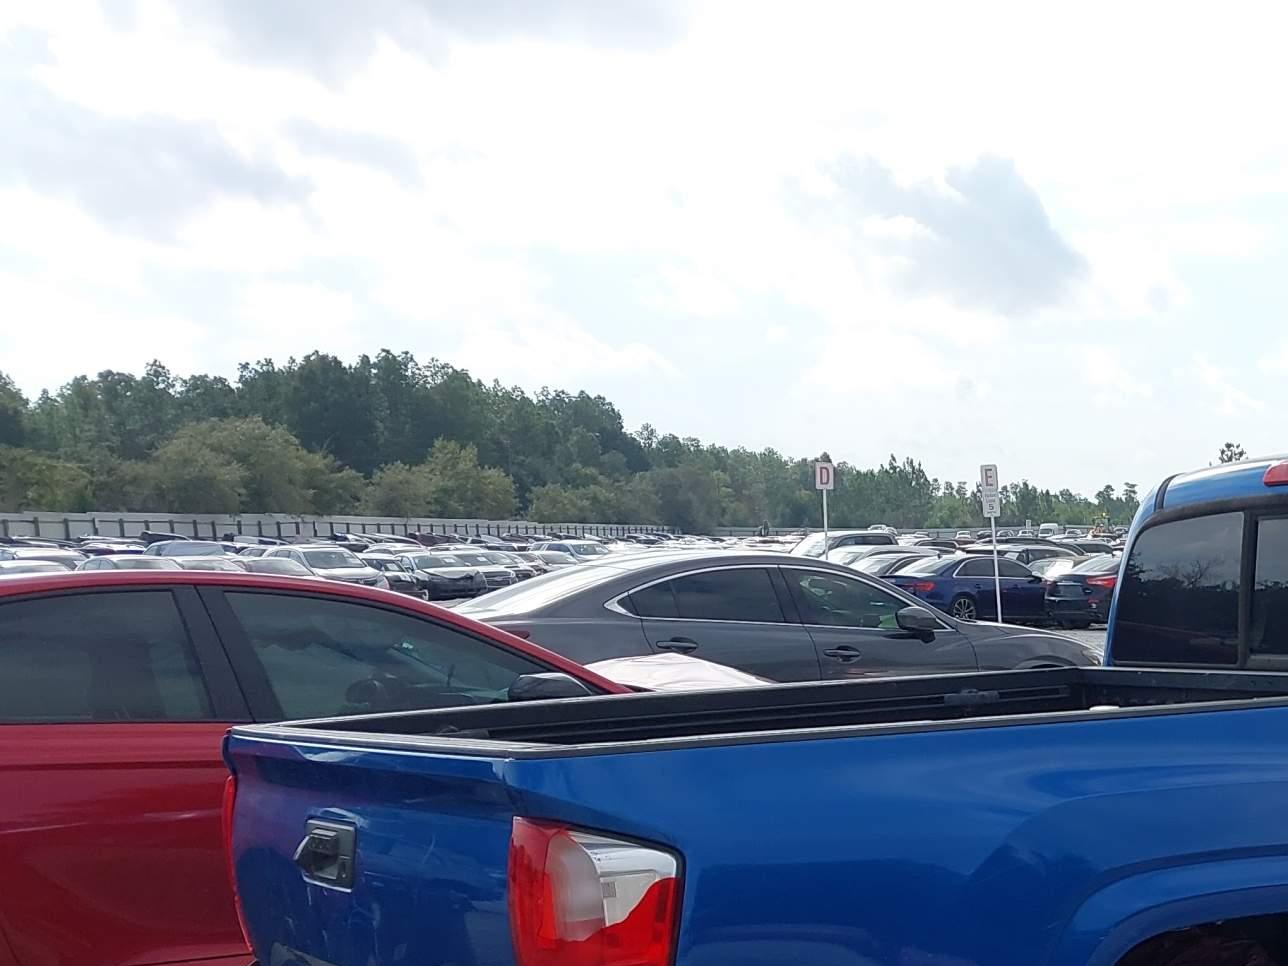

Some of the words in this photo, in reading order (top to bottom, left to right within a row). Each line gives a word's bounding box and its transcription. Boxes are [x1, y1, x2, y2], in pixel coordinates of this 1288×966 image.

[819, 466, 830, 485] D
[984, 468, 994, 487] E
[988, 503, 995, 511] 5
